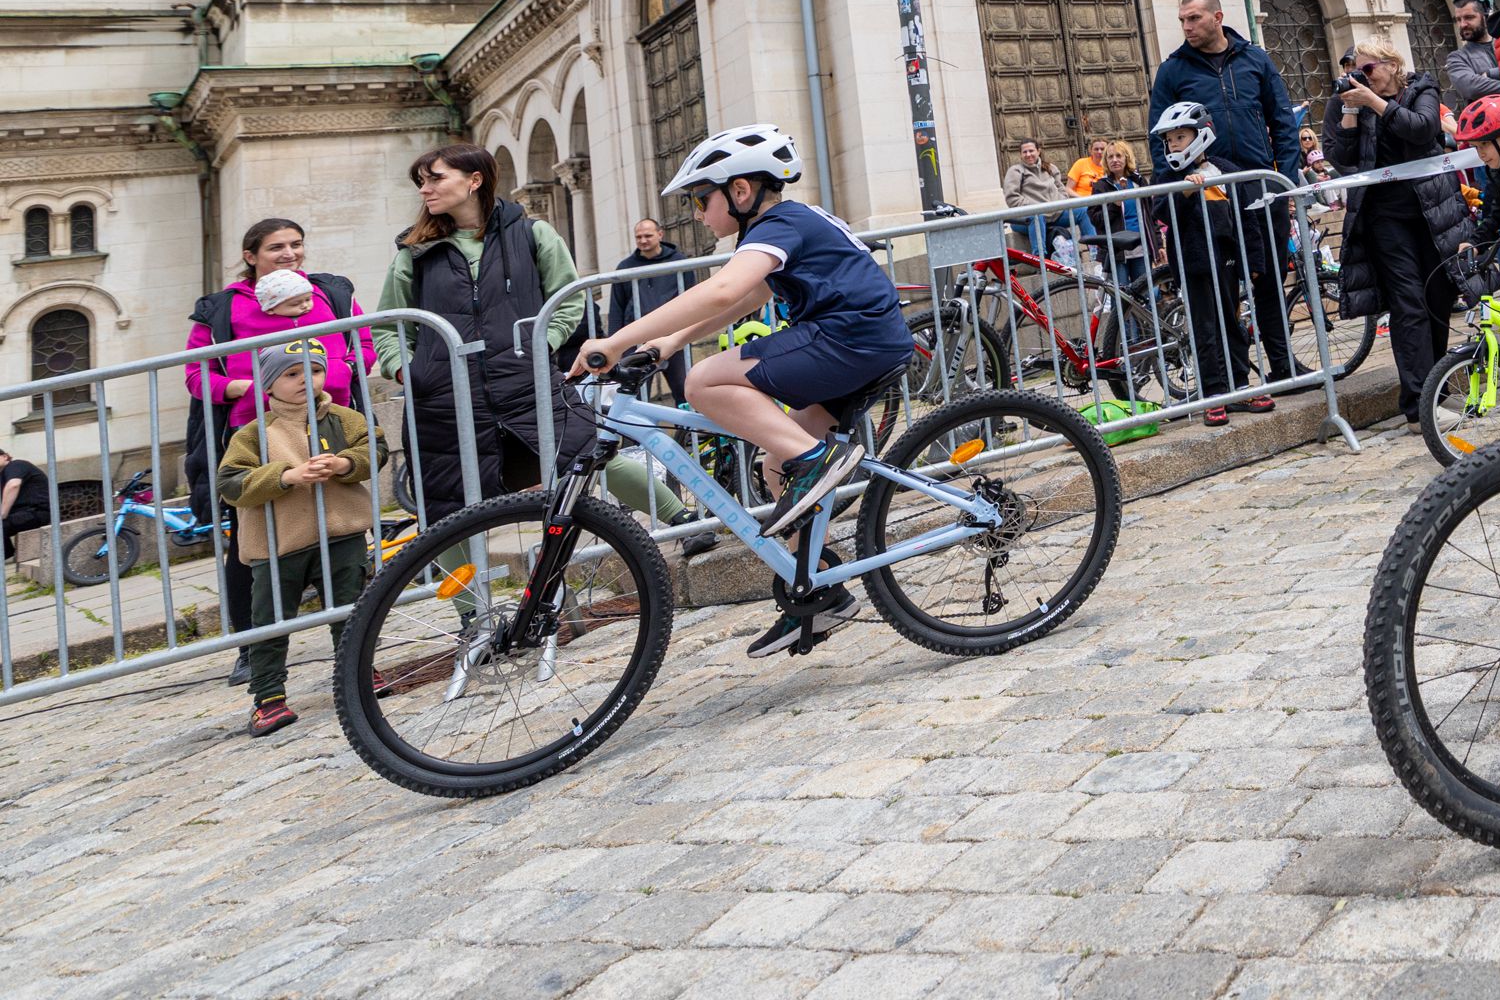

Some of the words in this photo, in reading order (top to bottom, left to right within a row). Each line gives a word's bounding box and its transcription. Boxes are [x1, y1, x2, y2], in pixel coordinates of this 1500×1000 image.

[549, 526, 563, 535] 03
[648, 436, 765, 549] ROCKRIDER
[1397, 486, 1471, 616] ROCKET
[1393, 624, 1409, 706] RON
